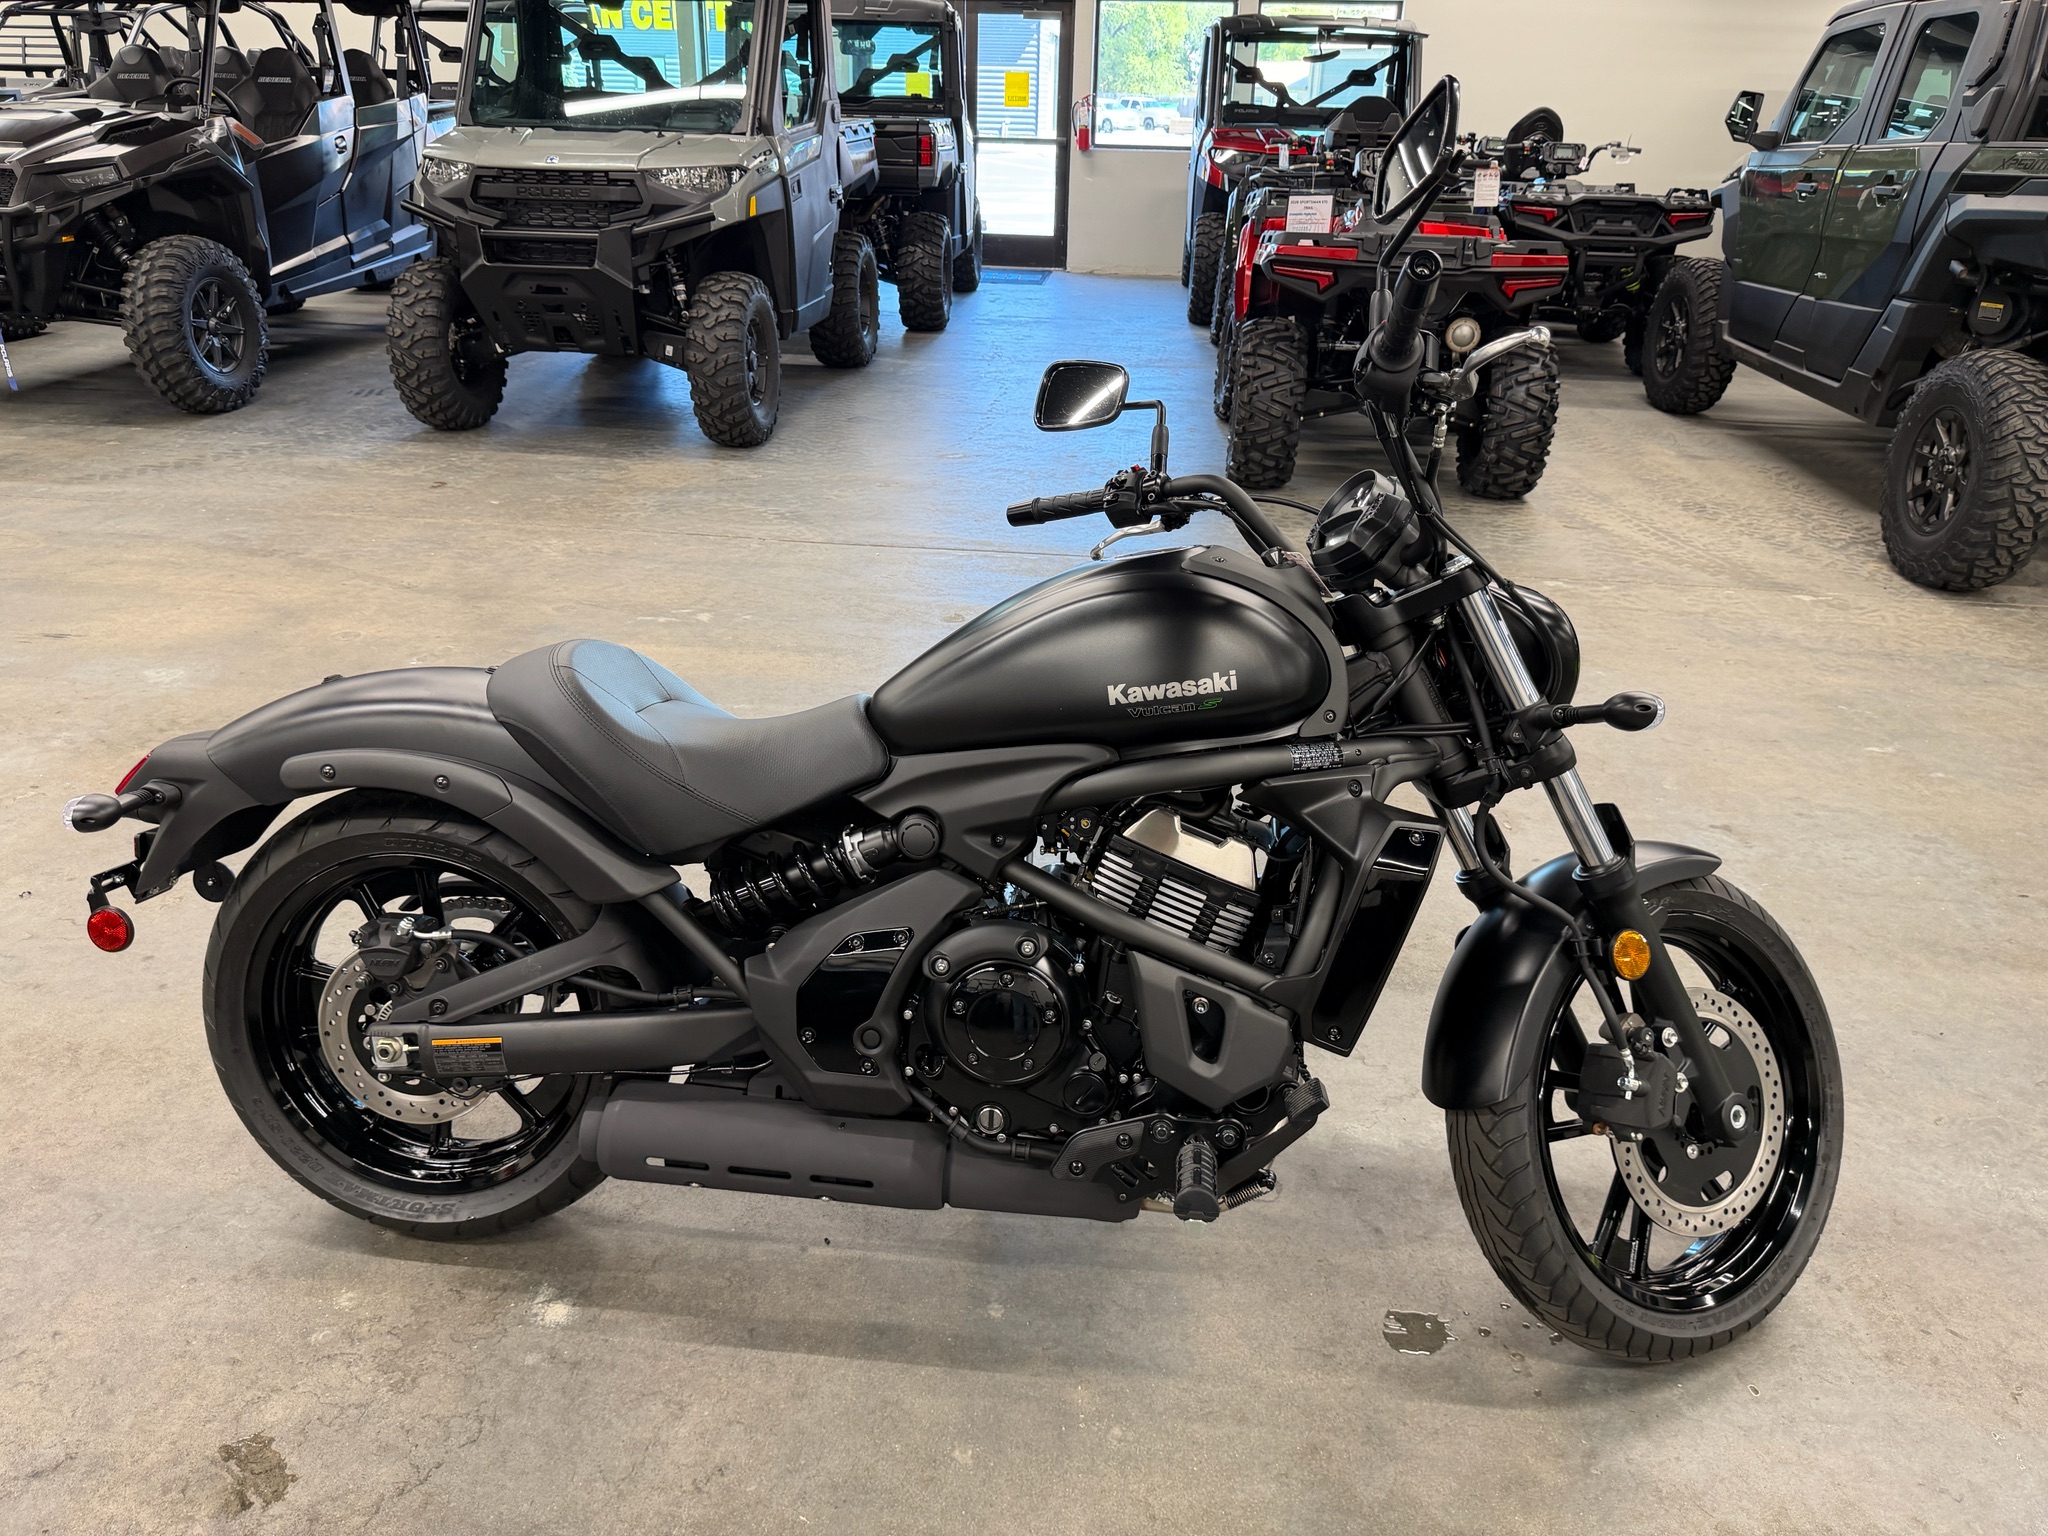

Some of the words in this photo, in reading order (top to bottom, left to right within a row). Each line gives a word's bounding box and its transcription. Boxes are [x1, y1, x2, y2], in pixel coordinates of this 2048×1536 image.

[257, 75, 293, 84] GENERAL
[516, 185, 591, 200] POLARIS
[0, 343, 14, 378] POLARIS
[1107, 669, 1238, 706] Kawasaki
[1127, 702, 1196, 718] Vulcan
[1198, 697, 1223, 710] S
[384, 837, 483, 862] DUNLOP
